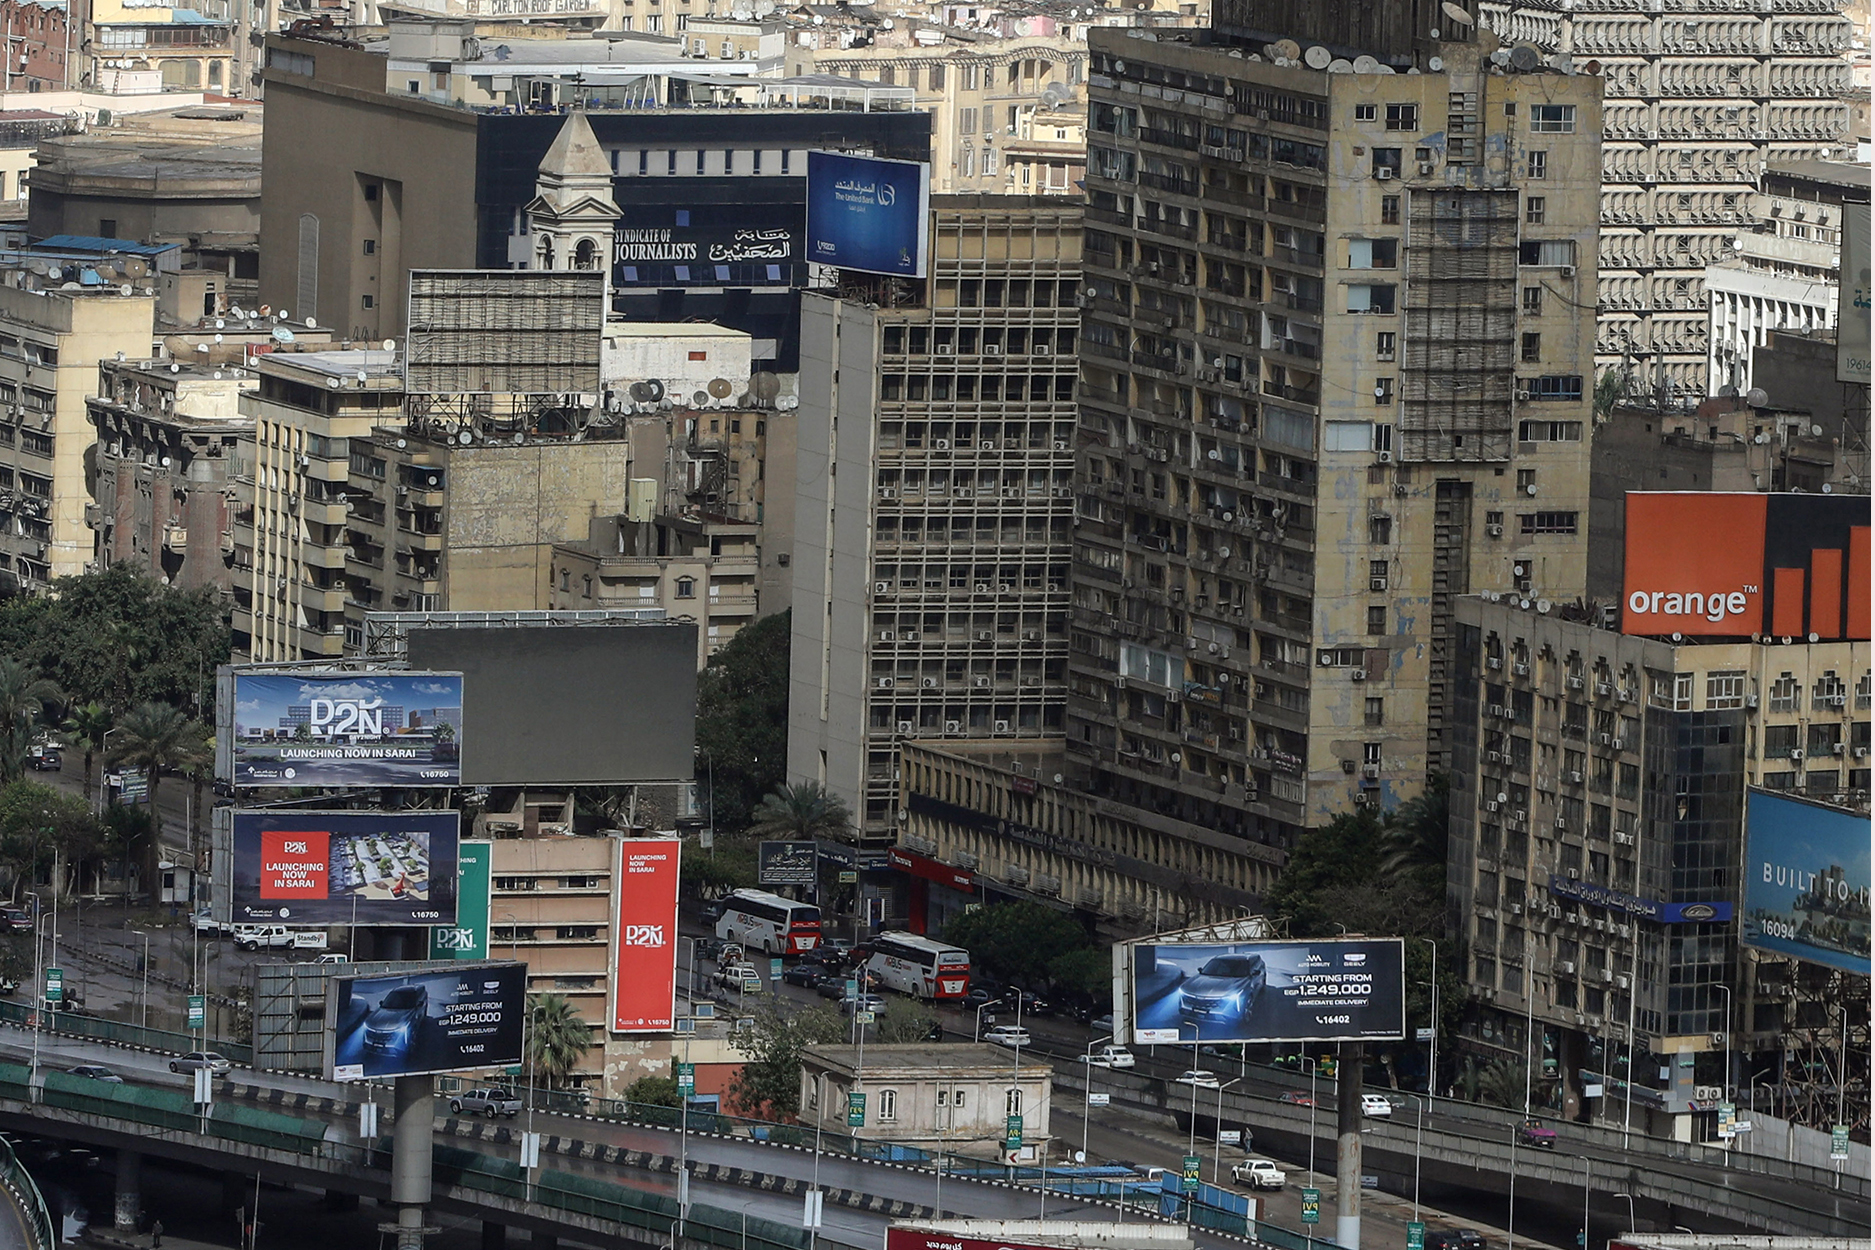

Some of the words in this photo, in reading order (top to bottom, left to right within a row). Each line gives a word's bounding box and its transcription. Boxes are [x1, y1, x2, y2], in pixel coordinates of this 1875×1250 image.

[531, 0, 551, 13] ROOF
[614, 230, 658, 244] SYNDICATE
[659, 229, 672, 242] OF
[613, 243, 697, 264] JOURNALISTS
[1630, 590, 1747, 624] orange
[280, 749, 344, 758] LAUNCHING
[344, 749, 371, 758] NOW
[372, 749, 384, 758] IN
[385, 749, 416, 758] SARAI
[425, 770, 449, 778] 16750
[266, 862, 324, 872] LAUNCHING
[282, 871, 307, 879] NOW
[274, 879, 284, 888] IN
[286, 879, 315, 888] SARAI
[1763, 862, 1816, 893] BUILT
[1826, 877, 1849, 901] TO
[416, 910, 439, 919] 16750
[1761, 919, 1795, 941] 16094
[297, 933, 321, 943] Standby
[1292, 974, 1342, 983] STARTING
[1343, 973, 1373, 982] FROM
[1299, 984, 1372, 996] 1,249,000
[445, 1003, 480, 1013] STARTING
[481, 1001, 502, 1011] FROM
[1334, 998, 1367, 1006] DELIVERY
[450, 1012, 502, 1025] 1,249,000
[1323, 1015, 1350, 1024] 16402
[473, 1027, 498, 1035] DELIVERY
